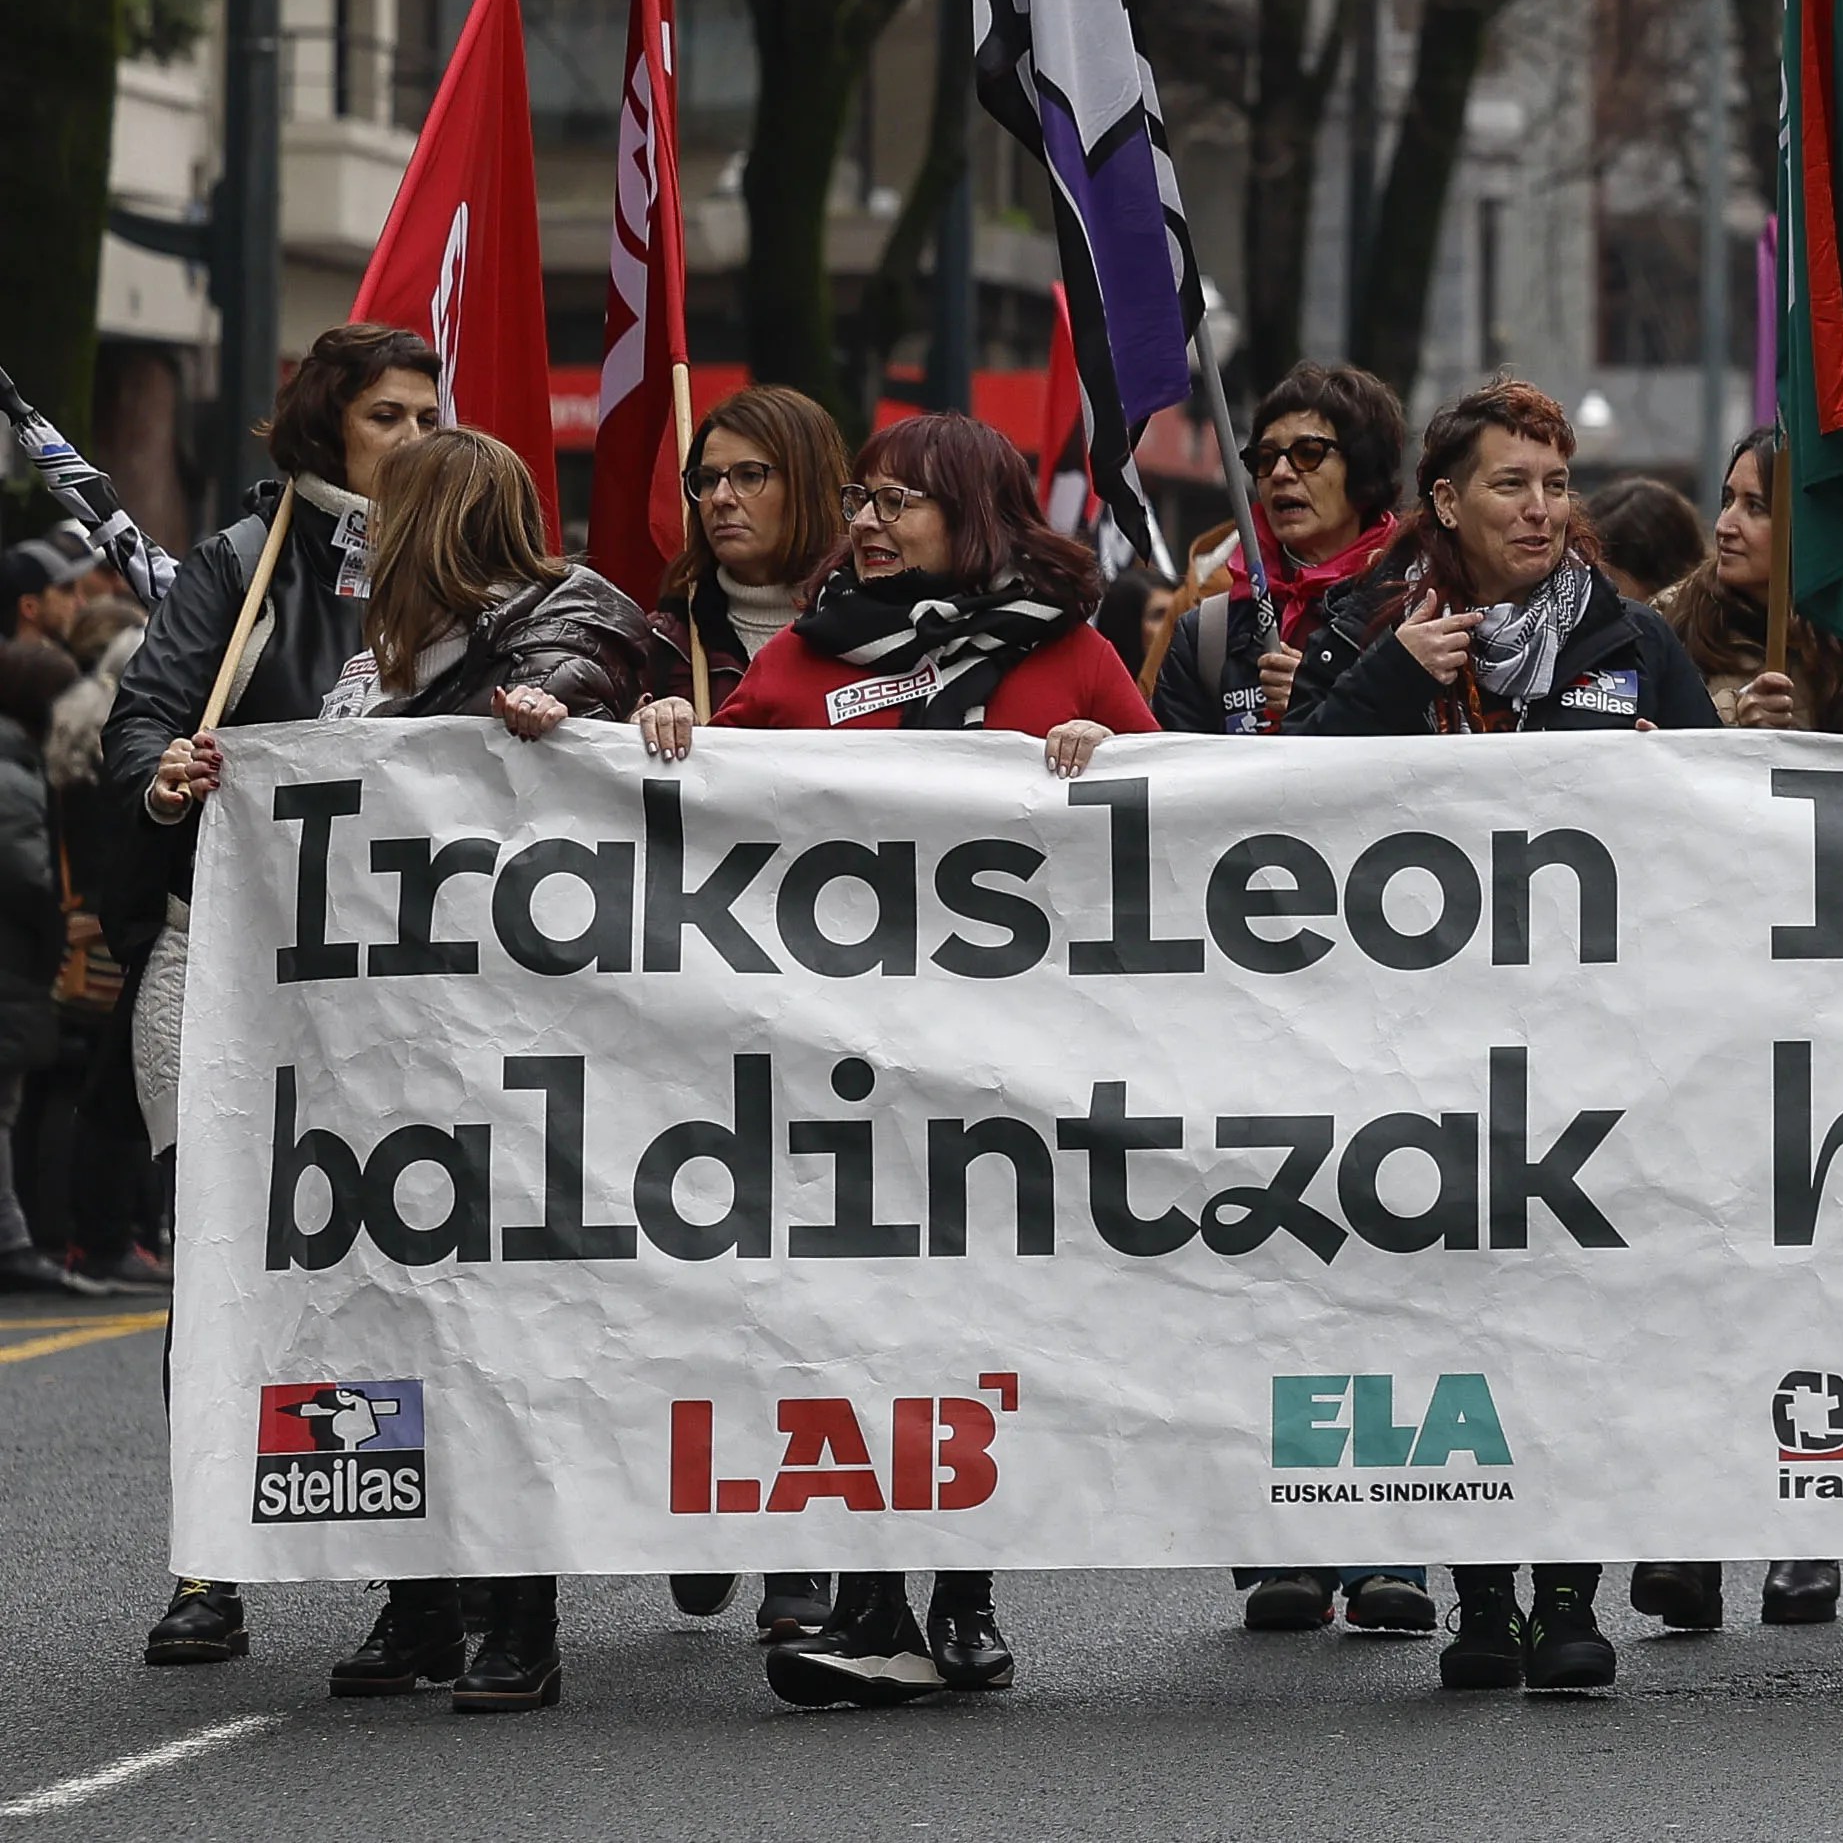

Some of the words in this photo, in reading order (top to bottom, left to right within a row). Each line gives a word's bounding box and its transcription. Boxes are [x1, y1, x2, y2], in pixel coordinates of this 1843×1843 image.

[864, 671, 932, 701] CCOO
[1561, 687, 1635, 716] steilas
[272, 777, 1619, 984] Irakasleon
[266, 1045, 1629, 1272] baldintzak
[672, 1397, 998, 1514] LAB
[1272, 1375, 1514, 1468] ELA
[258, 1458, 421, 1515] steilas
[1271, 1484, 1364, 1503] EUSKAL
[1369, 1482, 1515, 1503] SINDIKATUA
